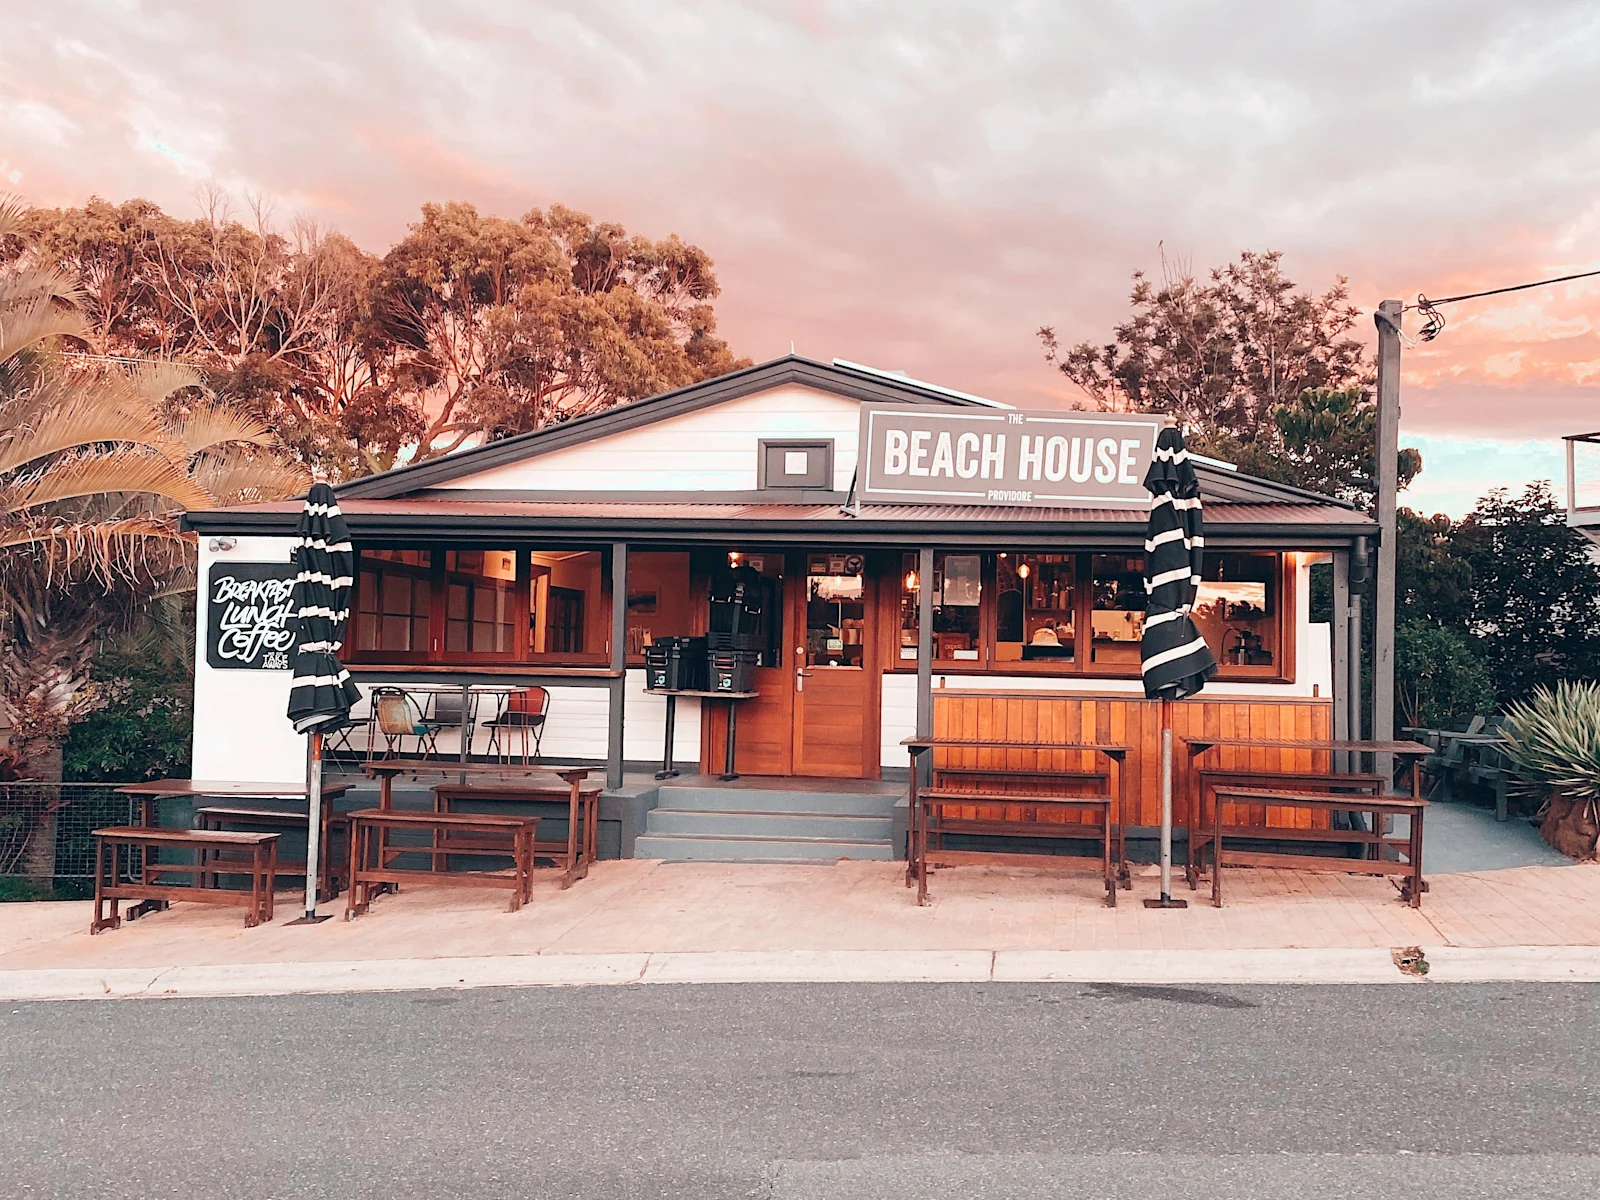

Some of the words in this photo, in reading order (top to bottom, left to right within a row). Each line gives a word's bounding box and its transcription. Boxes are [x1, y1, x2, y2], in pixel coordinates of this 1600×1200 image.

[1008, 413, 1023, 424] THE
[884, 429, 1006, 480] BEACH
[1018, 434, 1141, 484] HOUSE
[988, 489, 1032, 502] PROVIDORE
[212, 577, 298, 605] BREAKFAST
[220, 599, 298, 630] LUNCH
[218, 623, 295, 662] Coffee
[262, 654, 288, 664] TAKE
